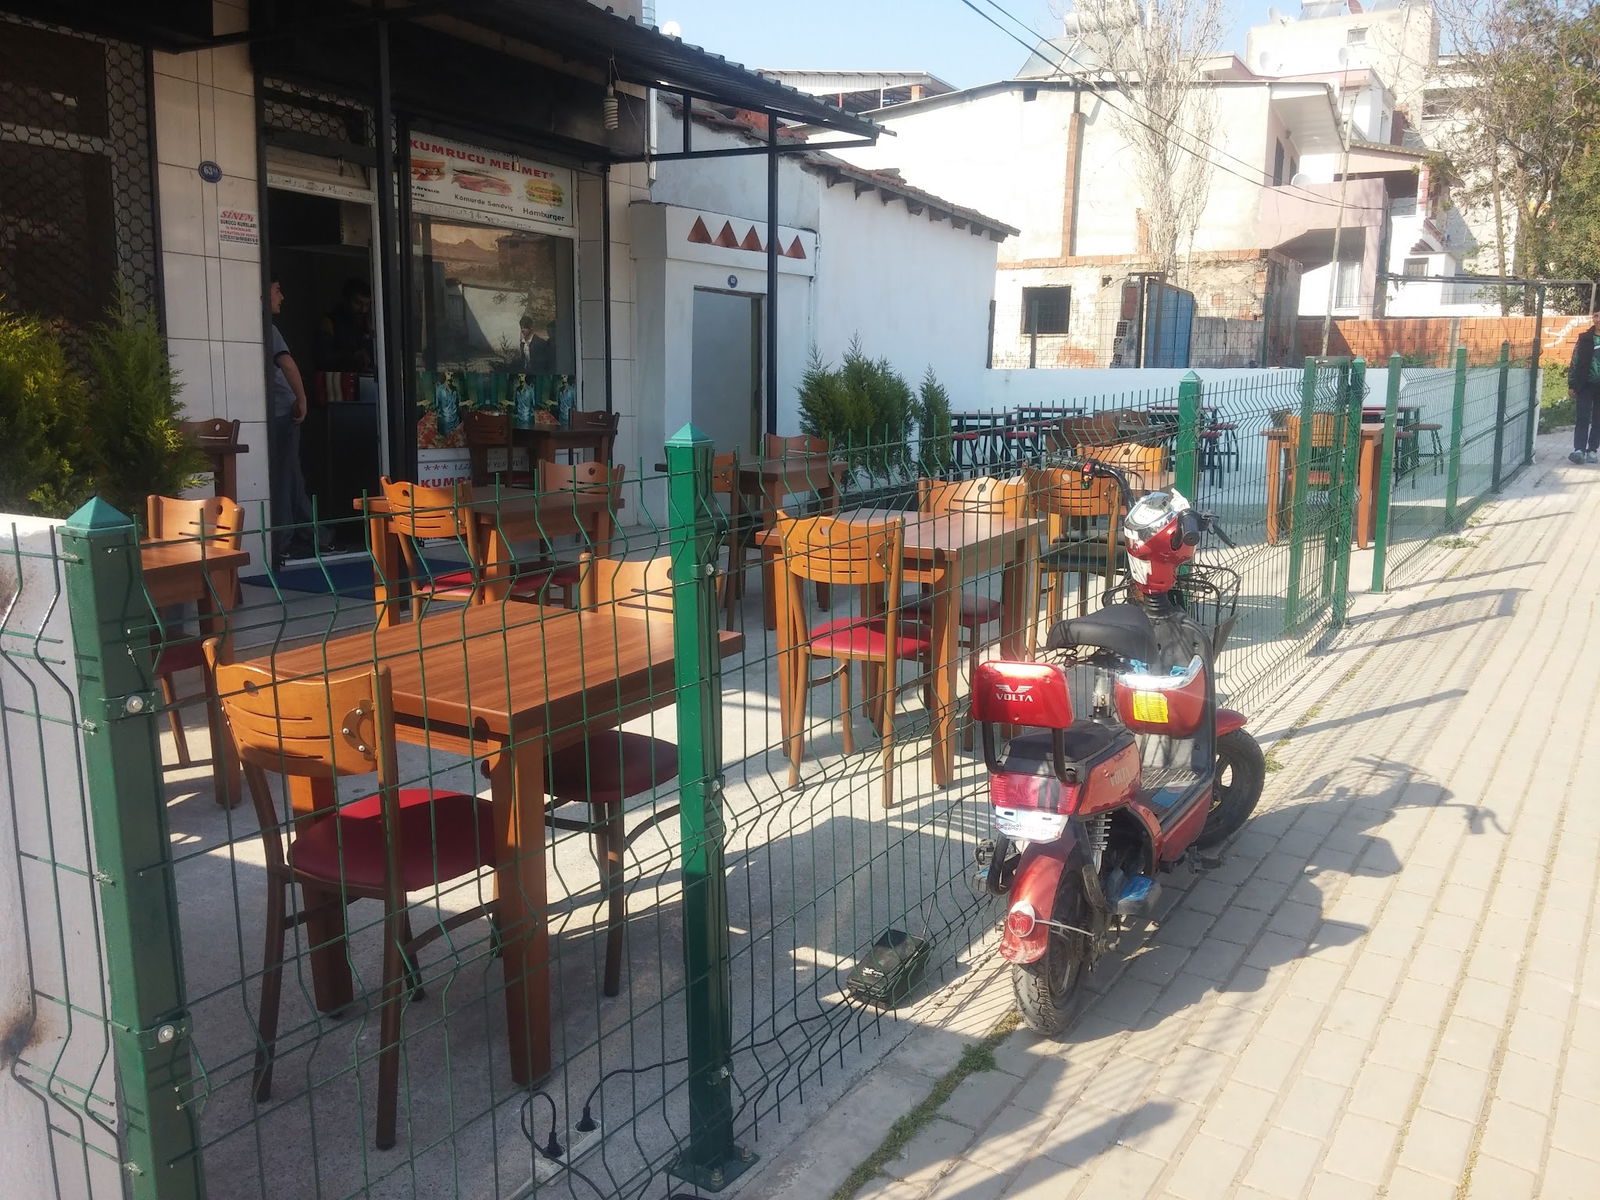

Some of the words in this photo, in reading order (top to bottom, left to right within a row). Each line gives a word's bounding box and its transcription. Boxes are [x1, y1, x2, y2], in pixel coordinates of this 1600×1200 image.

[409, 139, 485, 165] KUMRUCU
[522, 207, 566, 222] Hamburger
[995, 692, 1034, 703] VOLTA
